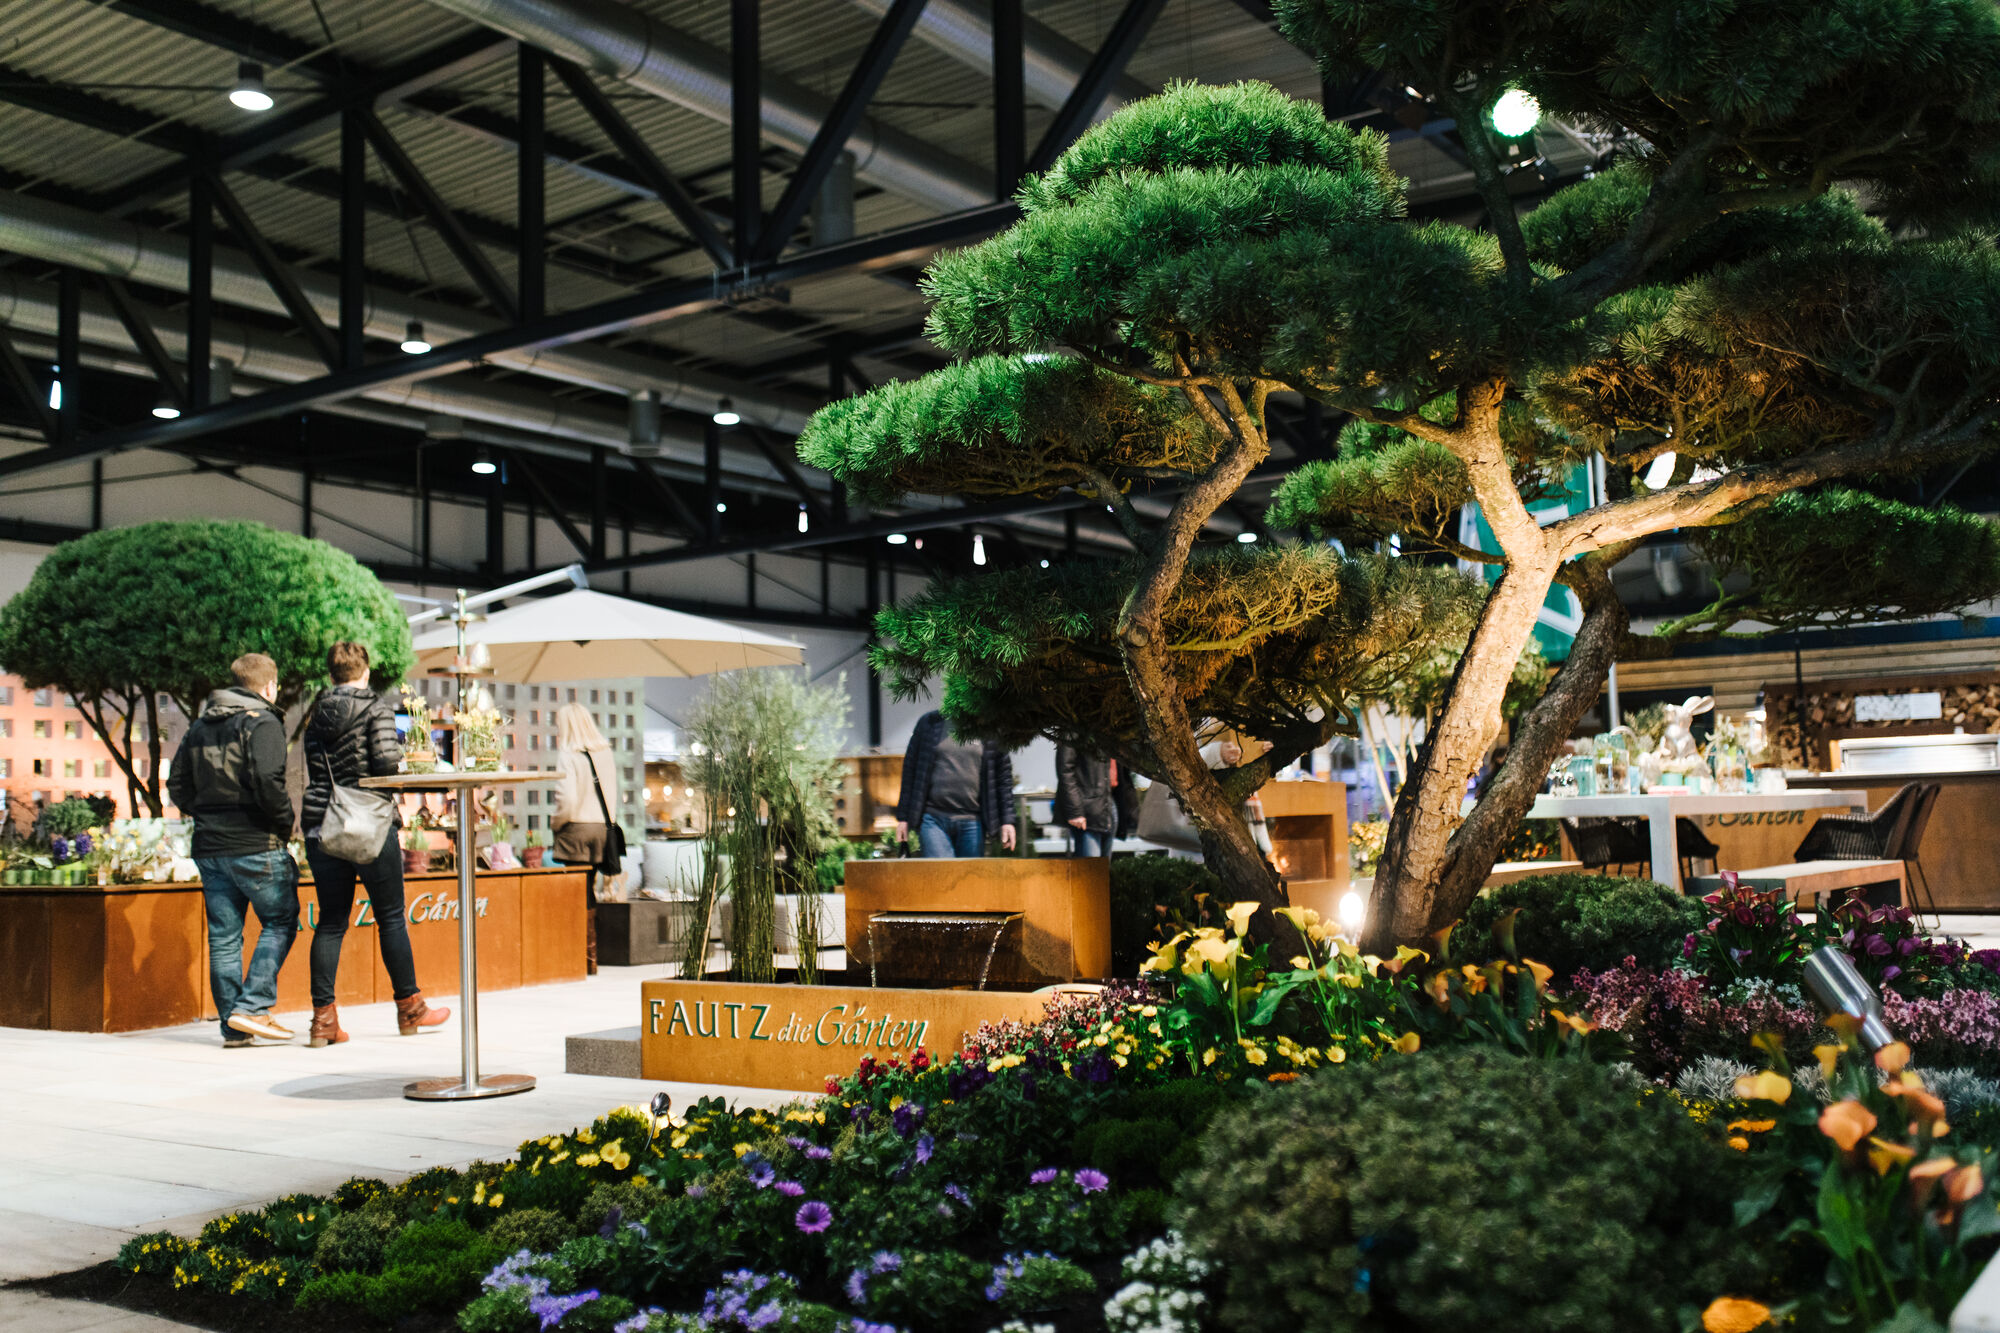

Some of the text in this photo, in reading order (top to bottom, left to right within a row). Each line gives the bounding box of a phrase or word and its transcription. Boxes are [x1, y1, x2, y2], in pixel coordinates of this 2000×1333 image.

[649, 998, 929, 1048] FAUTZ die Gärten
